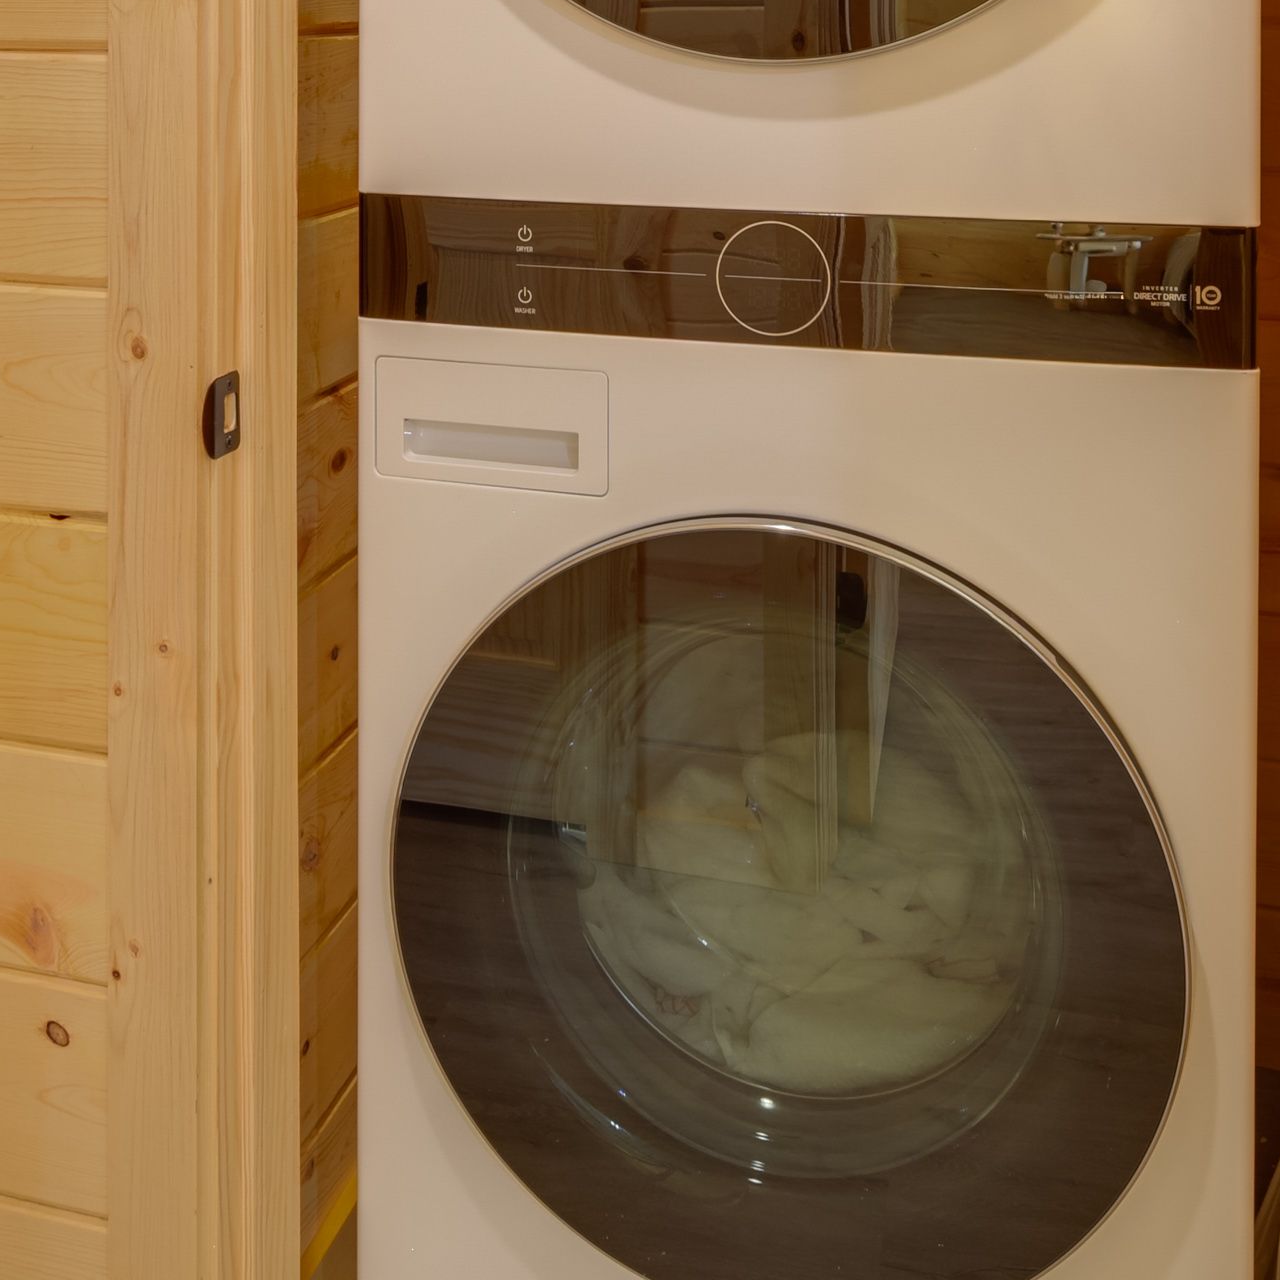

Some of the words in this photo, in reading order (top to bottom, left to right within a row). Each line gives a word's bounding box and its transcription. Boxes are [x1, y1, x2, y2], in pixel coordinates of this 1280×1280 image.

[516, 245, 534, 253] DRYER
[1133, 291, 1162, 301] DIRECT
[1163, 292, 1188, 302] DRIVE
[1195, 285, 1222, 305] 10
